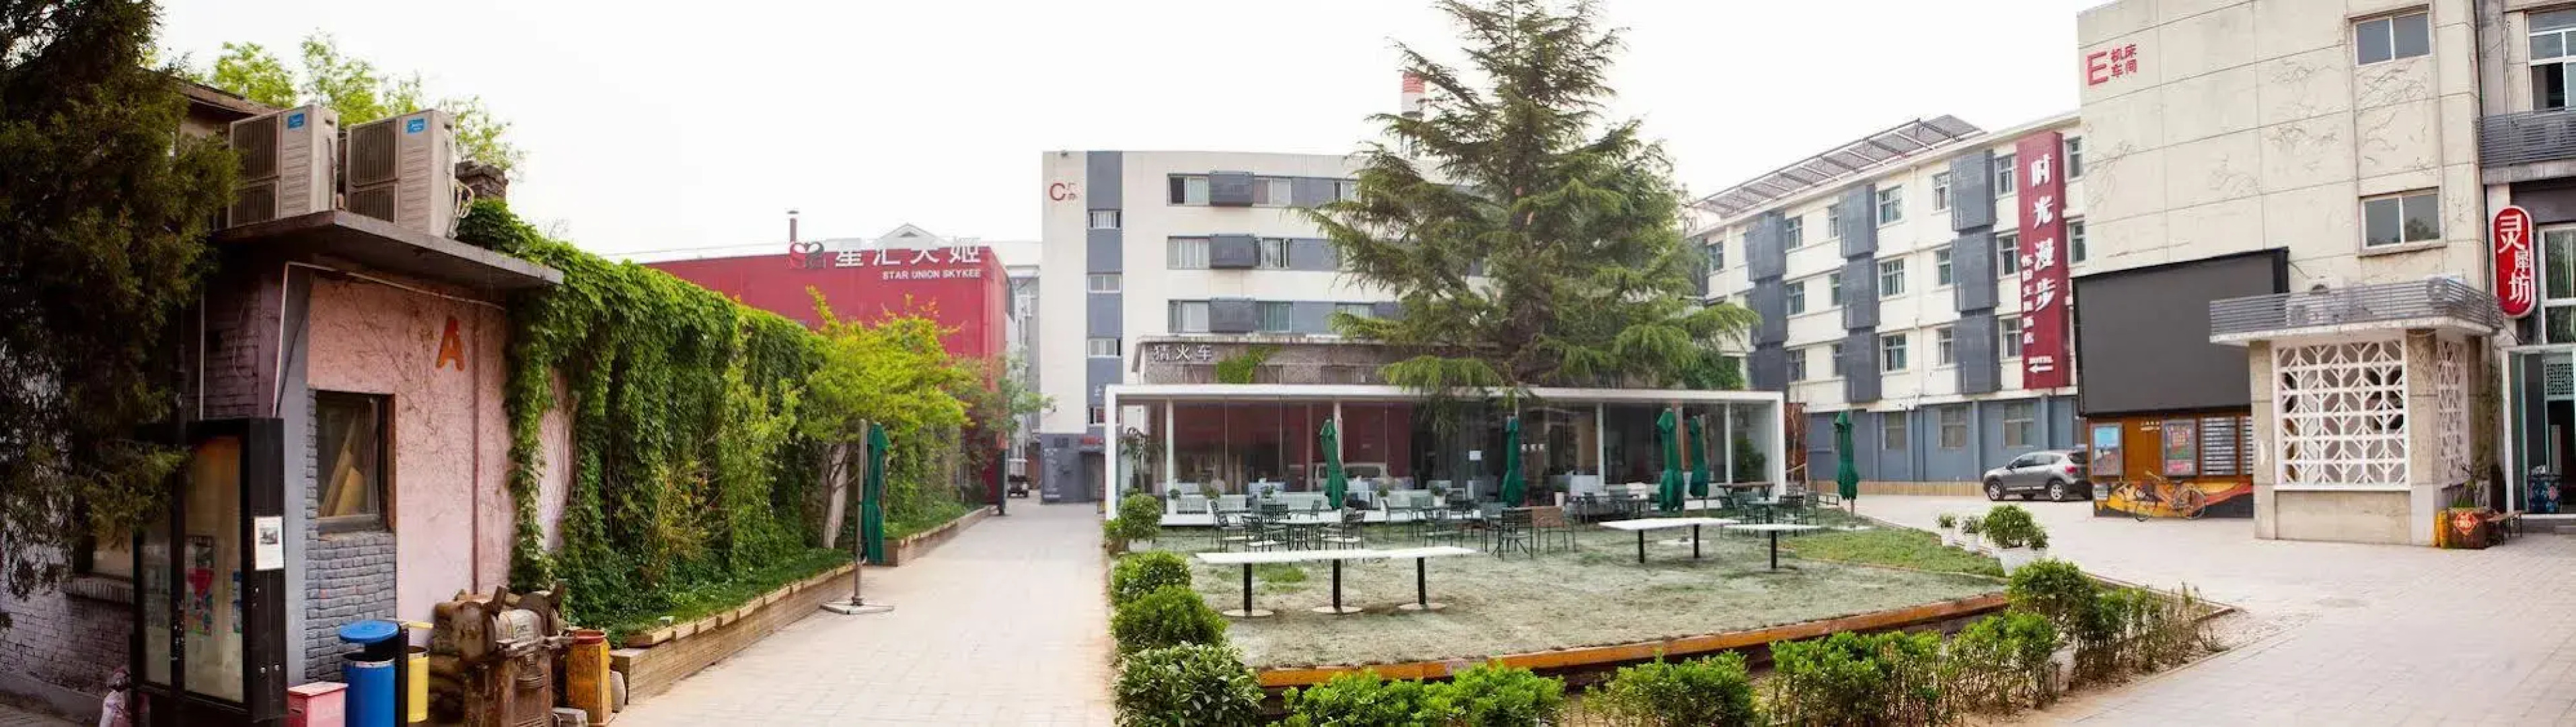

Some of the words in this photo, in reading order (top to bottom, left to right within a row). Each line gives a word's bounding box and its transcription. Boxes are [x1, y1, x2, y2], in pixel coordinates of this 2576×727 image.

[2111, 44, 2137, 63] 机床
[2088, 51, 2108, 85] E
[2111, 59, 2137, 78] 车间
[1050, 182, 1066, 201] C
[2031, 153, 2056, 312] 时光漫步
[2497, 213, 2530, 304] 灵犀坊
[882, 269, 909, 280] STAR
[912, 269, 940, 279] UNION
[943, 268, 981, 279] SKYKEE
[435, 316, 466, 371] A
